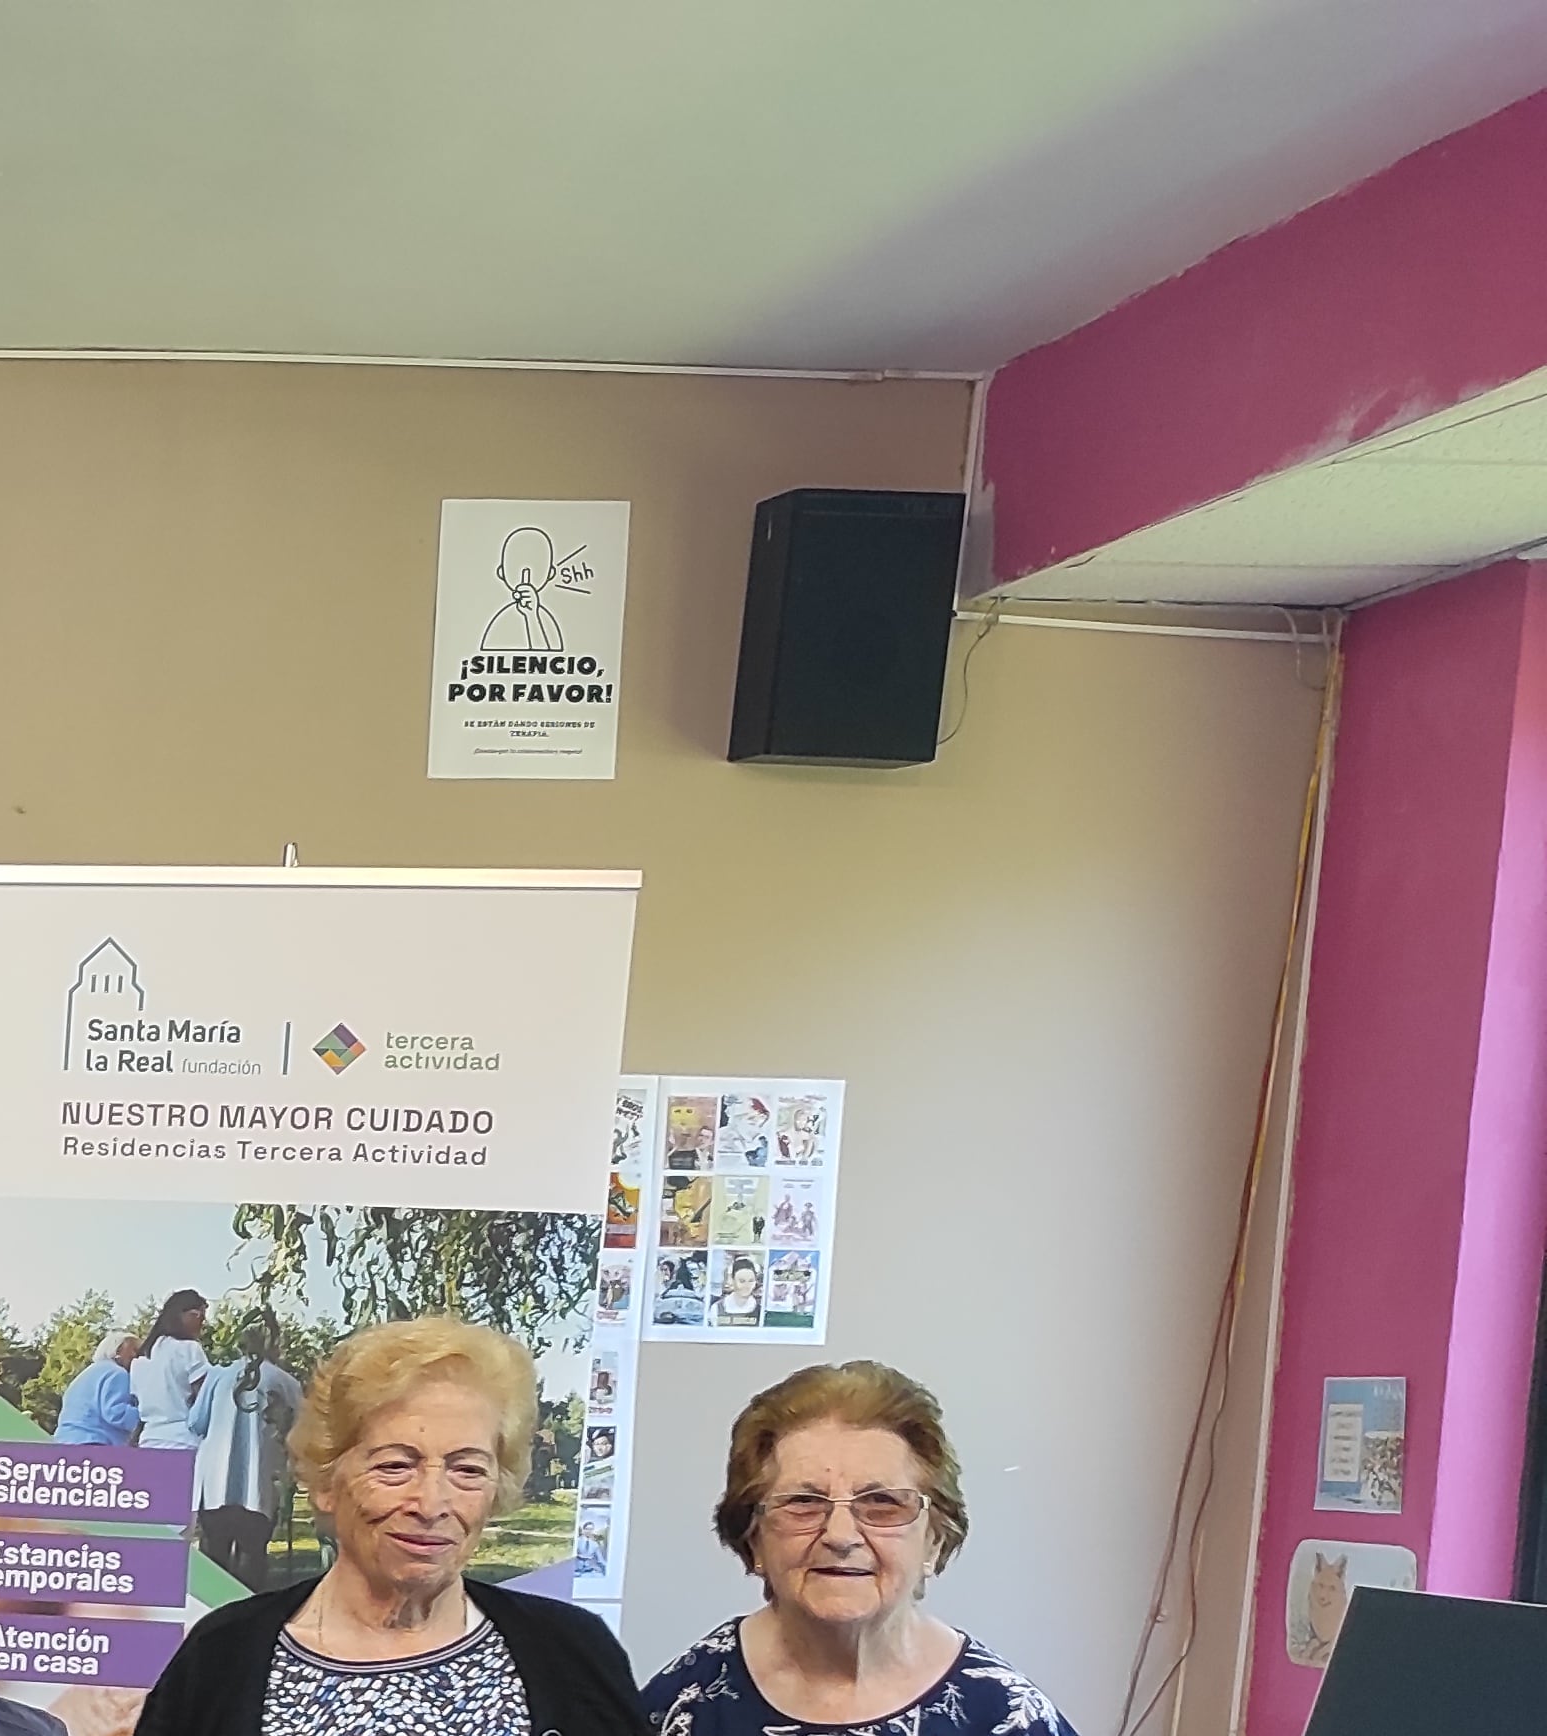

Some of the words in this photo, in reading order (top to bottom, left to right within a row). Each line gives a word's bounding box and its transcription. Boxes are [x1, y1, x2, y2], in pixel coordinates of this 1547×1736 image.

[561, 562, 594, 584] Shh
[461, 656, 605, 680] ¡SILENCIO,
[448, 684, 505, 702] POR
[512, 684, 613, 703] FAVOR!
[87, 1017, 160, 1043] Santa
[167, 1019, 241, 1044] María
[385, 1030, 474, 1051] tercera
[85, 1050, 108, 1072] la
[117, 1050, 172, 1074] Real
[181, 1057, 262, 1076] fundación
[384, 1050, 500, 1071] actividad
[61, 1101, 209, 1128] NUESTRO
[218, 1104, 333, 1132] MAYOR
[345, 1107, 494, 1134] CUIDADO
[62, 1136, 227, 1161] Residencias
[236, 1139, 343, 1163] Tercera
[351, 1142, 488, 1166] Actividad
[33, 1655, 99, 1675] casa
